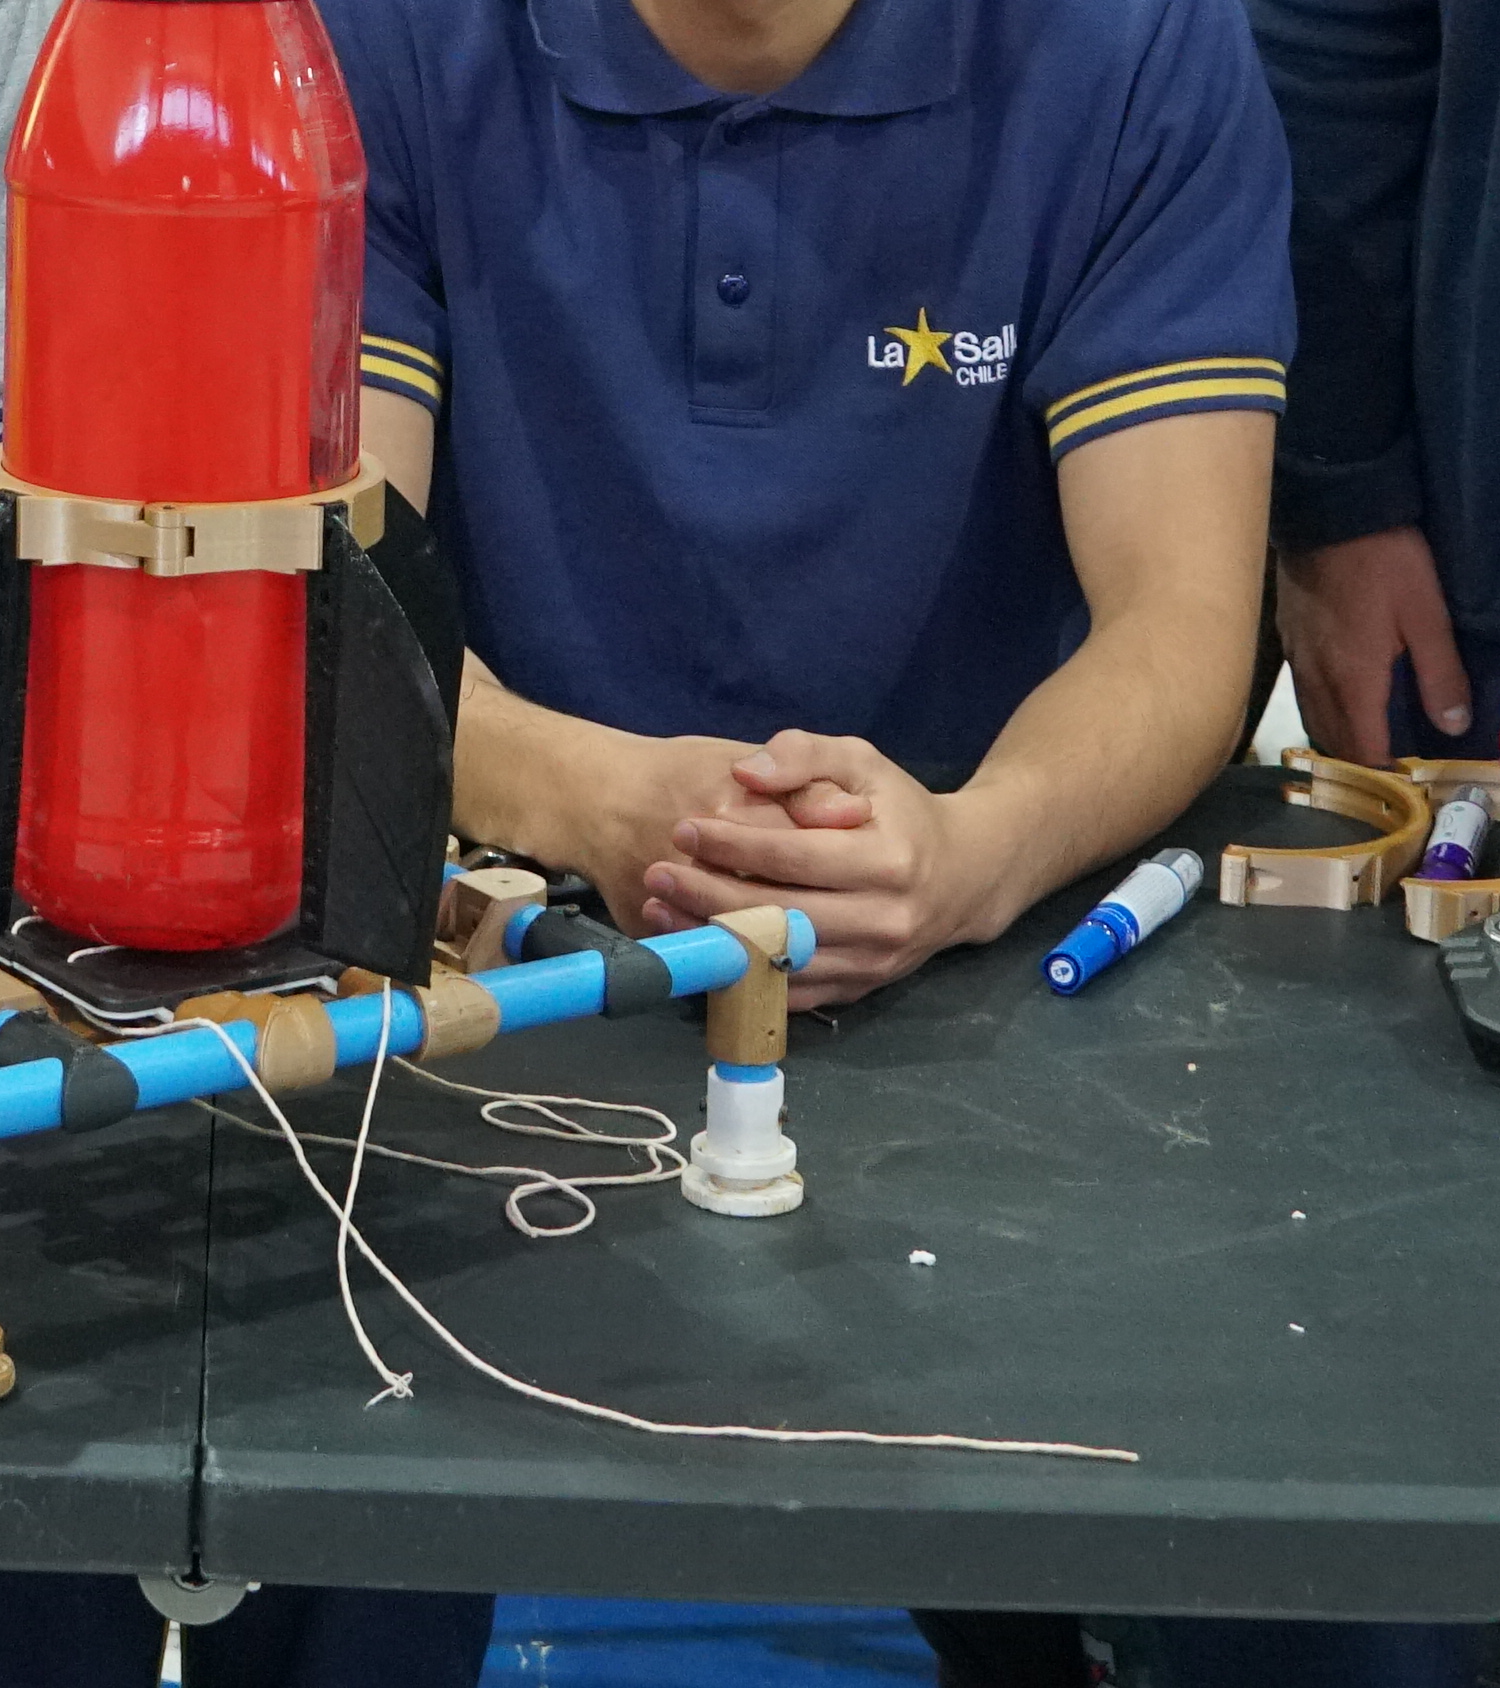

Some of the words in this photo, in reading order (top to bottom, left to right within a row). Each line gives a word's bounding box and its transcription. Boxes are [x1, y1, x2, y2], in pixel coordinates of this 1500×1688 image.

[867, 335, 905, 369] La
[953, 322, 1018, 364] Sall
[955, 361, 1008, 387] CHILE
